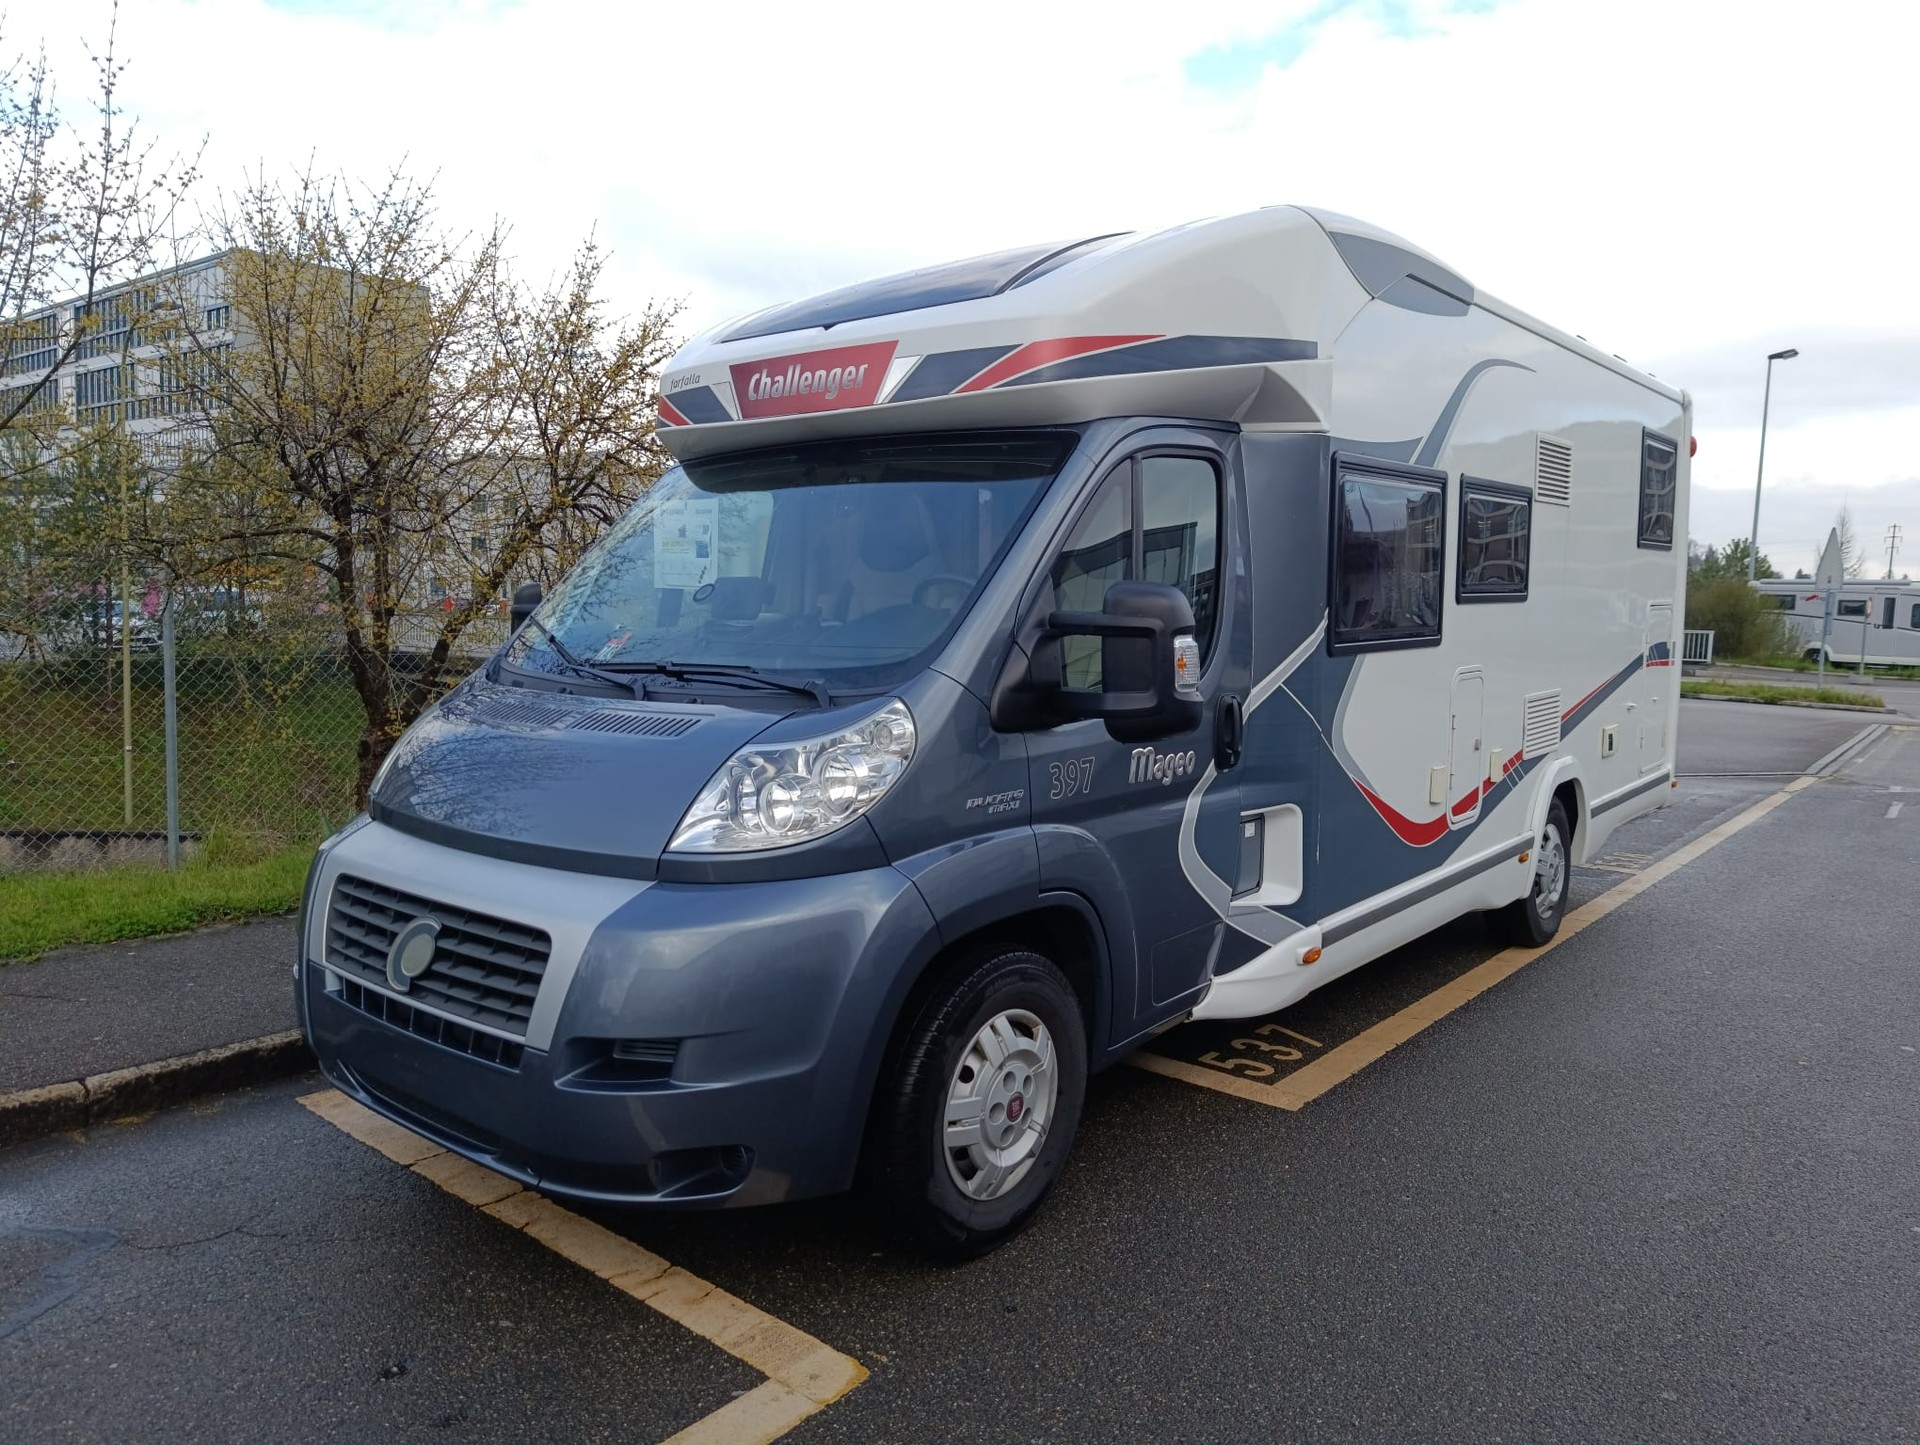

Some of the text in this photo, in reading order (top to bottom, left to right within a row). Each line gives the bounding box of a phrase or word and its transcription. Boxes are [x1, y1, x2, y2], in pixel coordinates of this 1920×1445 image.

[669, 373, 701, 392] farfalla
[748, 363, 869, 401] Challenger
[1050, 756, 1096, 800] 397
[1128, 746, 1197, 786] Mageo
[1198, 1023, 1324, 1077] 537
